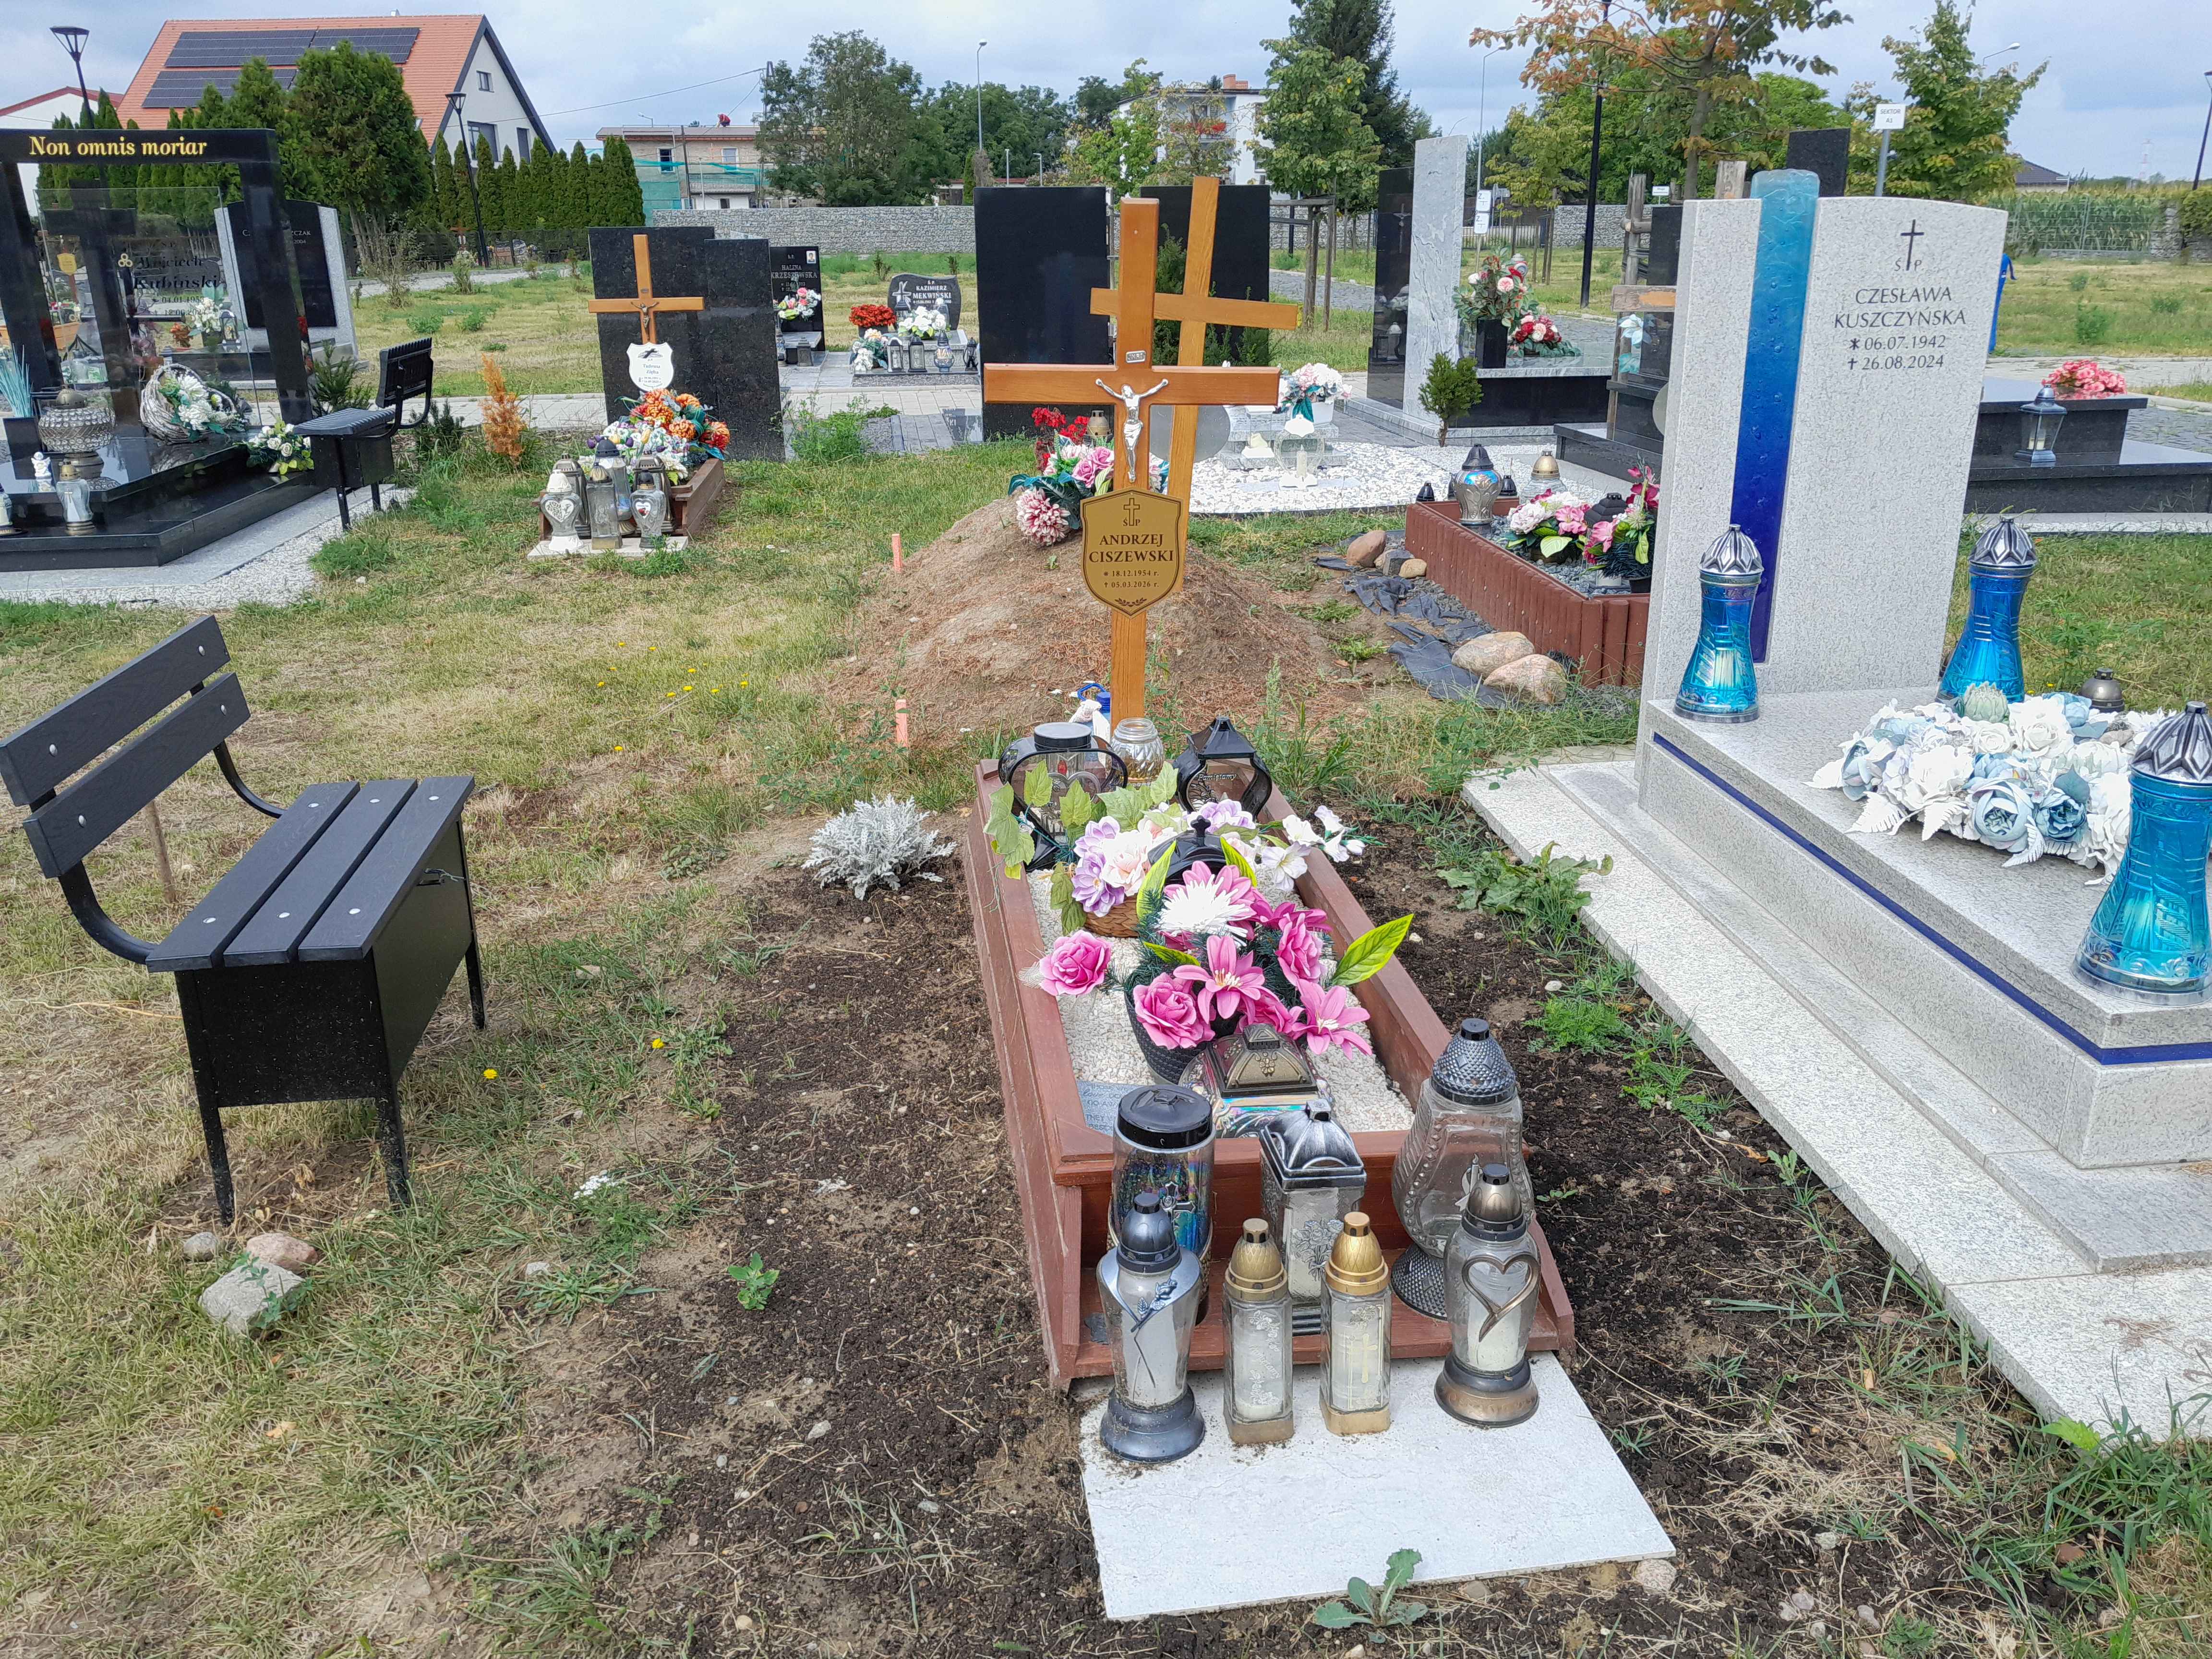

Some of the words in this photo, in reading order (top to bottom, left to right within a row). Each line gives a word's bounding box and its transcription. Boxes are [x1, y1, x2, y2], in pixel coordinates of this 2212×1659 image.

[29, 136, 71, 155] Non
[77, 136, 135, 155] omnis
[142, 136, 207, 155] moriar
[1855, 287, 1952, 304] CZESŁAWA
[1834, 306, 1966, 328] KUSZCZYŃSKA
[1864, 335, 1946, 350] 06.07.1942
[1862, 355, 1944, 370] 26.08.2024
[1099, 534, 1164, 547] ANDRZEJ
[1089, 550, 1174, 562] CISZEWSKI
[1198, 773, 1237, 781] Pamiętamy
